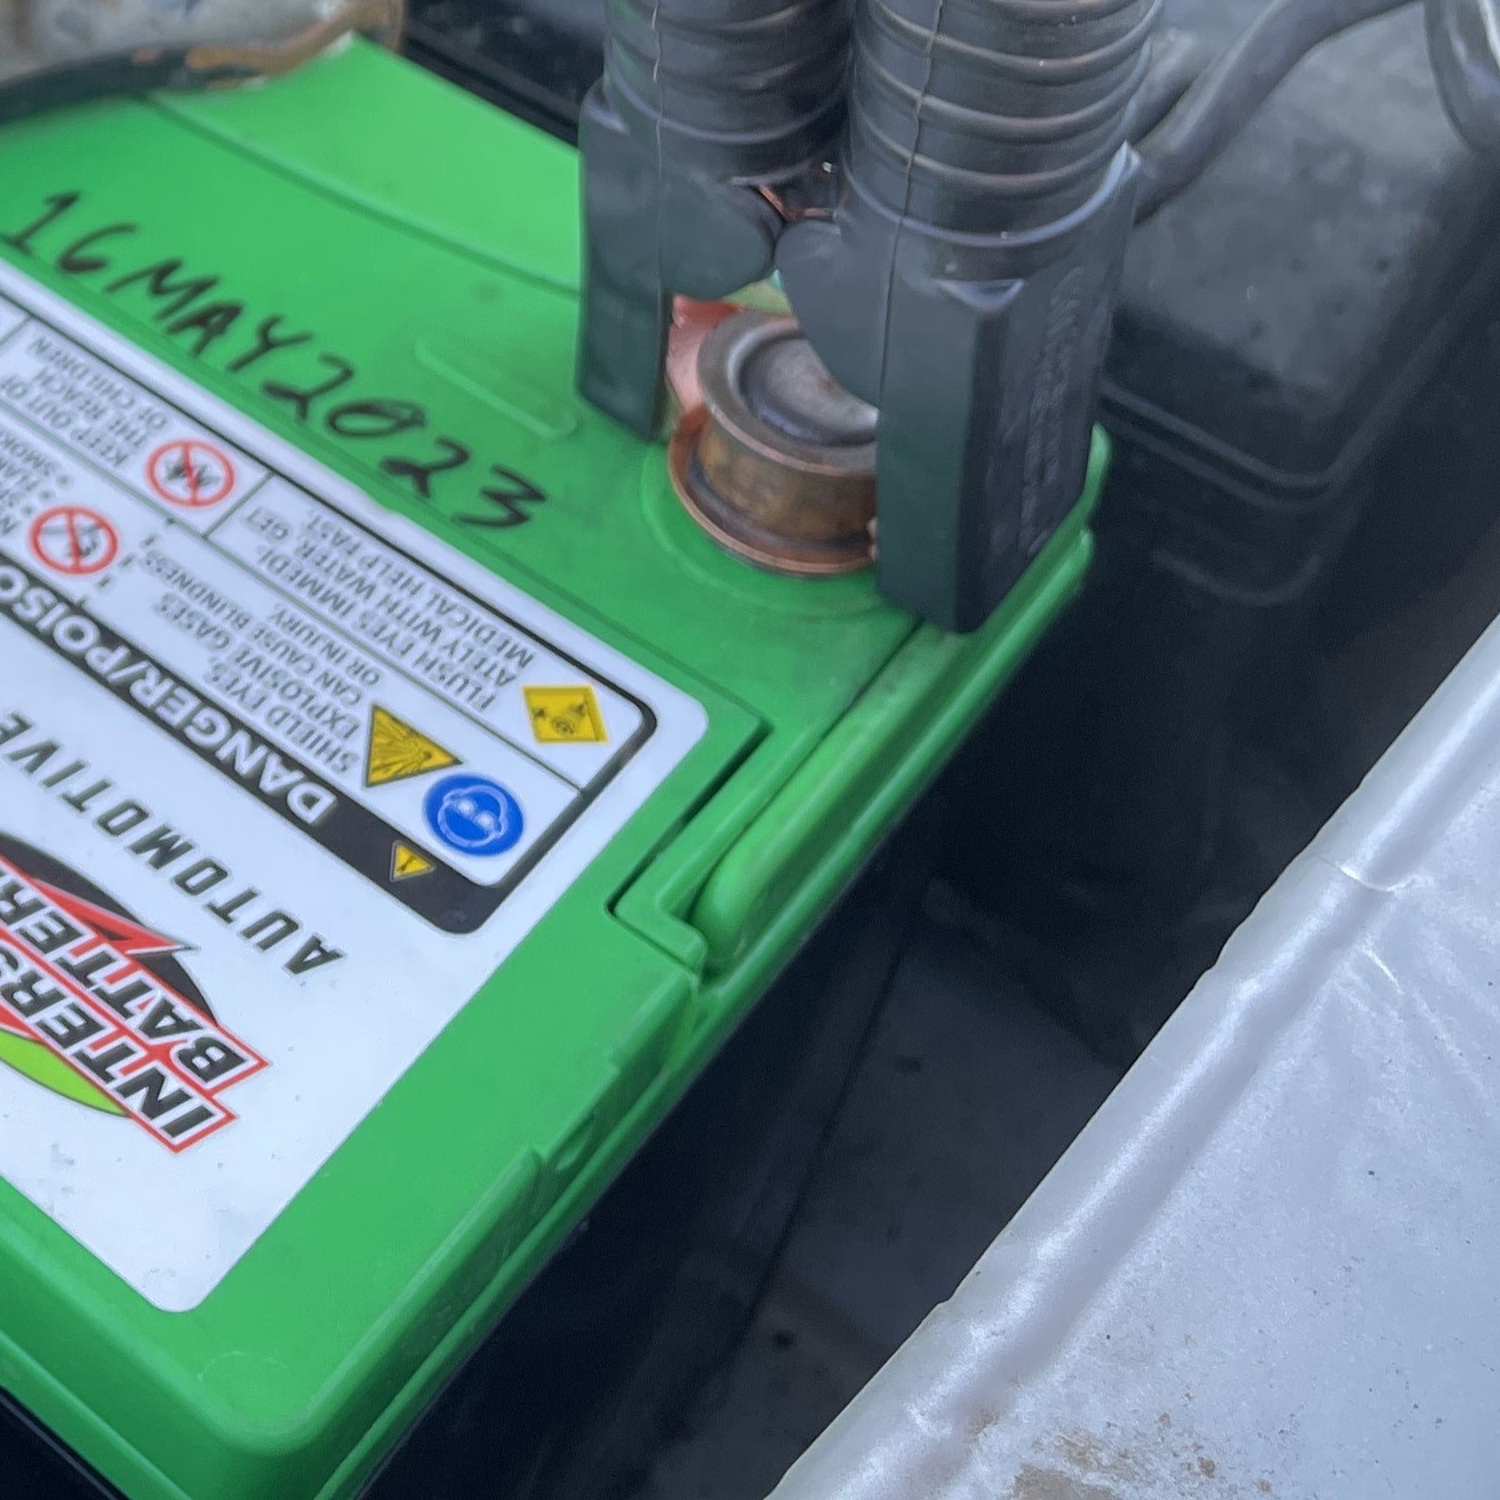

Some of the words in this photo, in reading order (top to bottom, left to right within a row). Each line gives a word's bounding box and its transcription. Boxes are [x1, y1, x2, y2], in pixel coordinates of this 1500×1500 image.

[24, 392, 78, 431] OUT
[29, 366, 108, 422] REACH
[67, 421, 131, 468] KEEP
[104, 416, 150, 450] THE
[241, 503, 296, 545] GET
[136, 547, 253, 632] BLINDNESS
[355, 546, 428, 599] HELP
[151, 590, 236, 654] GASES
[349, 608, 418, 660] EYES
[372, 590, 446, 646] WITH
[416, 585, 538, 673] MEDICAL
[246, 623, 319, 678] CAUSE
[340, 654, 385, 690] OR
[436, 633, 517, 693] ATELY
[226, 642, 362, 742] EXPLOSIVE
[311, 668, 365, 710] CAN
[409, 648, 497, 714] FLUSH
[260, 699, 361, 776] SHIELD
